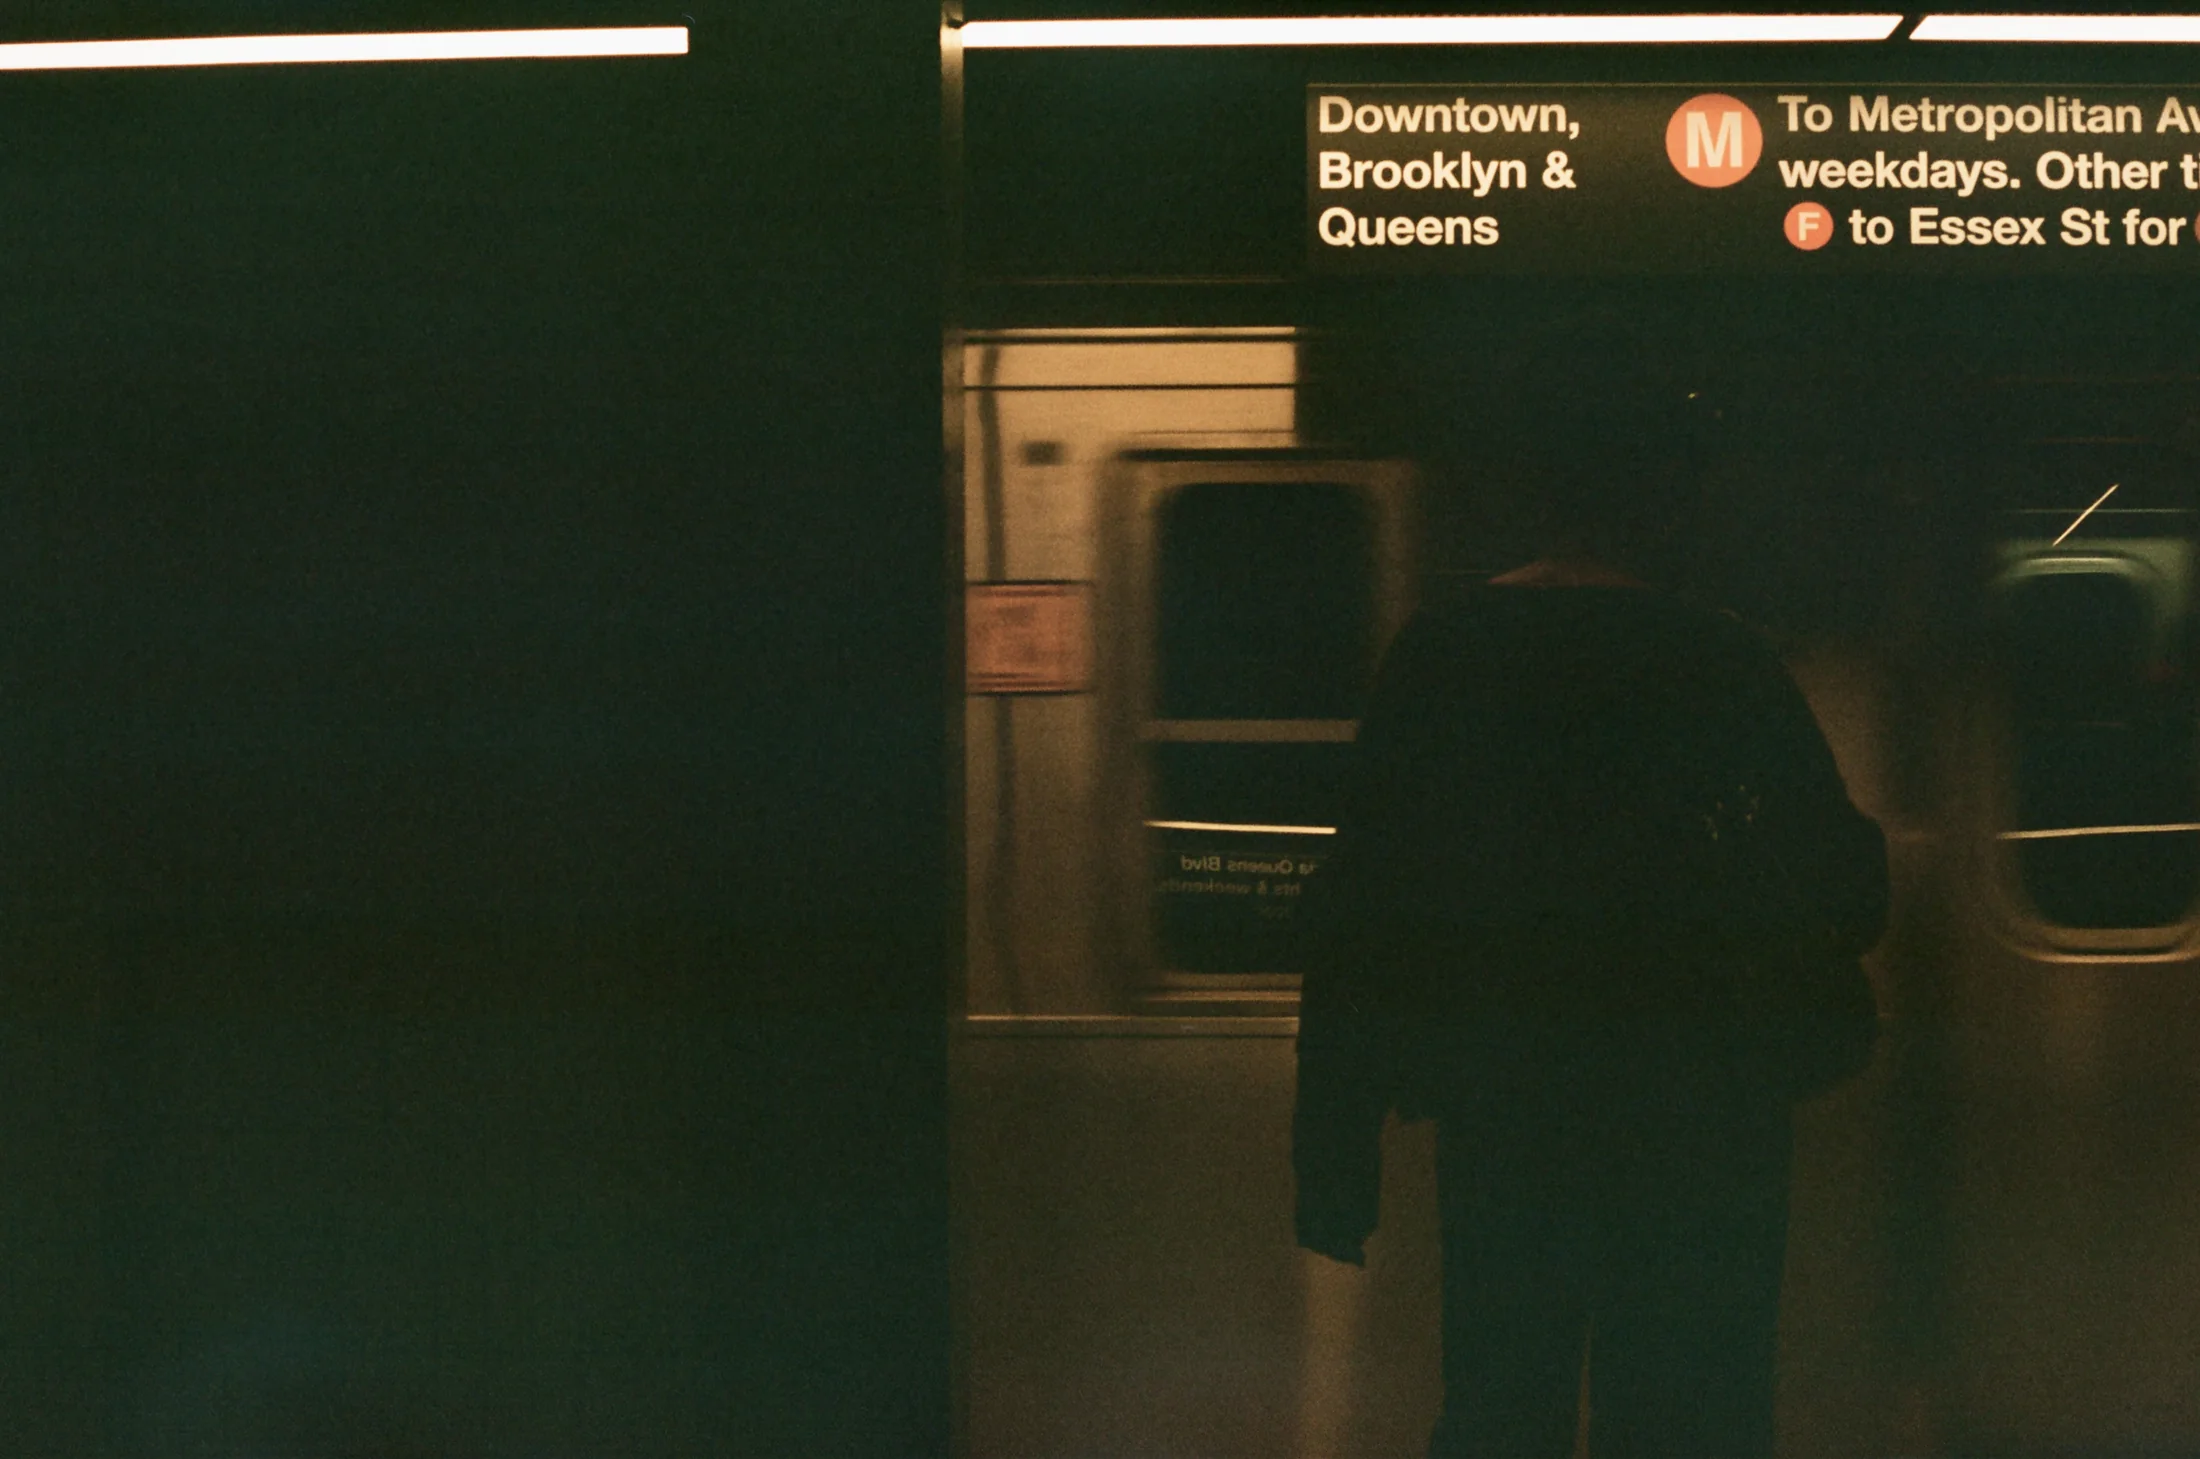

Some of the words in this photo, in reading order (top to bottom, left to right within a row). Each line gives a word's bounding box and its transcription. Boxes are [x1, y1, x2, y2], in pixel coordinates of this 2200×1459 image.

[1318, 95, 1580, 141] Downtown,
[1684, 110, 1743, 169] M
[1777, 95, 1833, 133] To
[1849, 95, 2143, 142] Metropolitan
[1319, 150, 1527, 198] Brooklyn
[1541, 150, 1577, 190] &
[1777, 150, 2021, 198] weekdays.
[2035, 150, 2169, 190] Other
[2179, 153, 2200, 190] t
[1318, 206, 1500, 248] Queens
[1797, 210, 1822, 242] F
[1847, 208, 1894, 246] to
[1909, 206, 2047, 246] Essex
[2060, 206, 2111, 246] St
[2121, 208, 2187, 246] for
